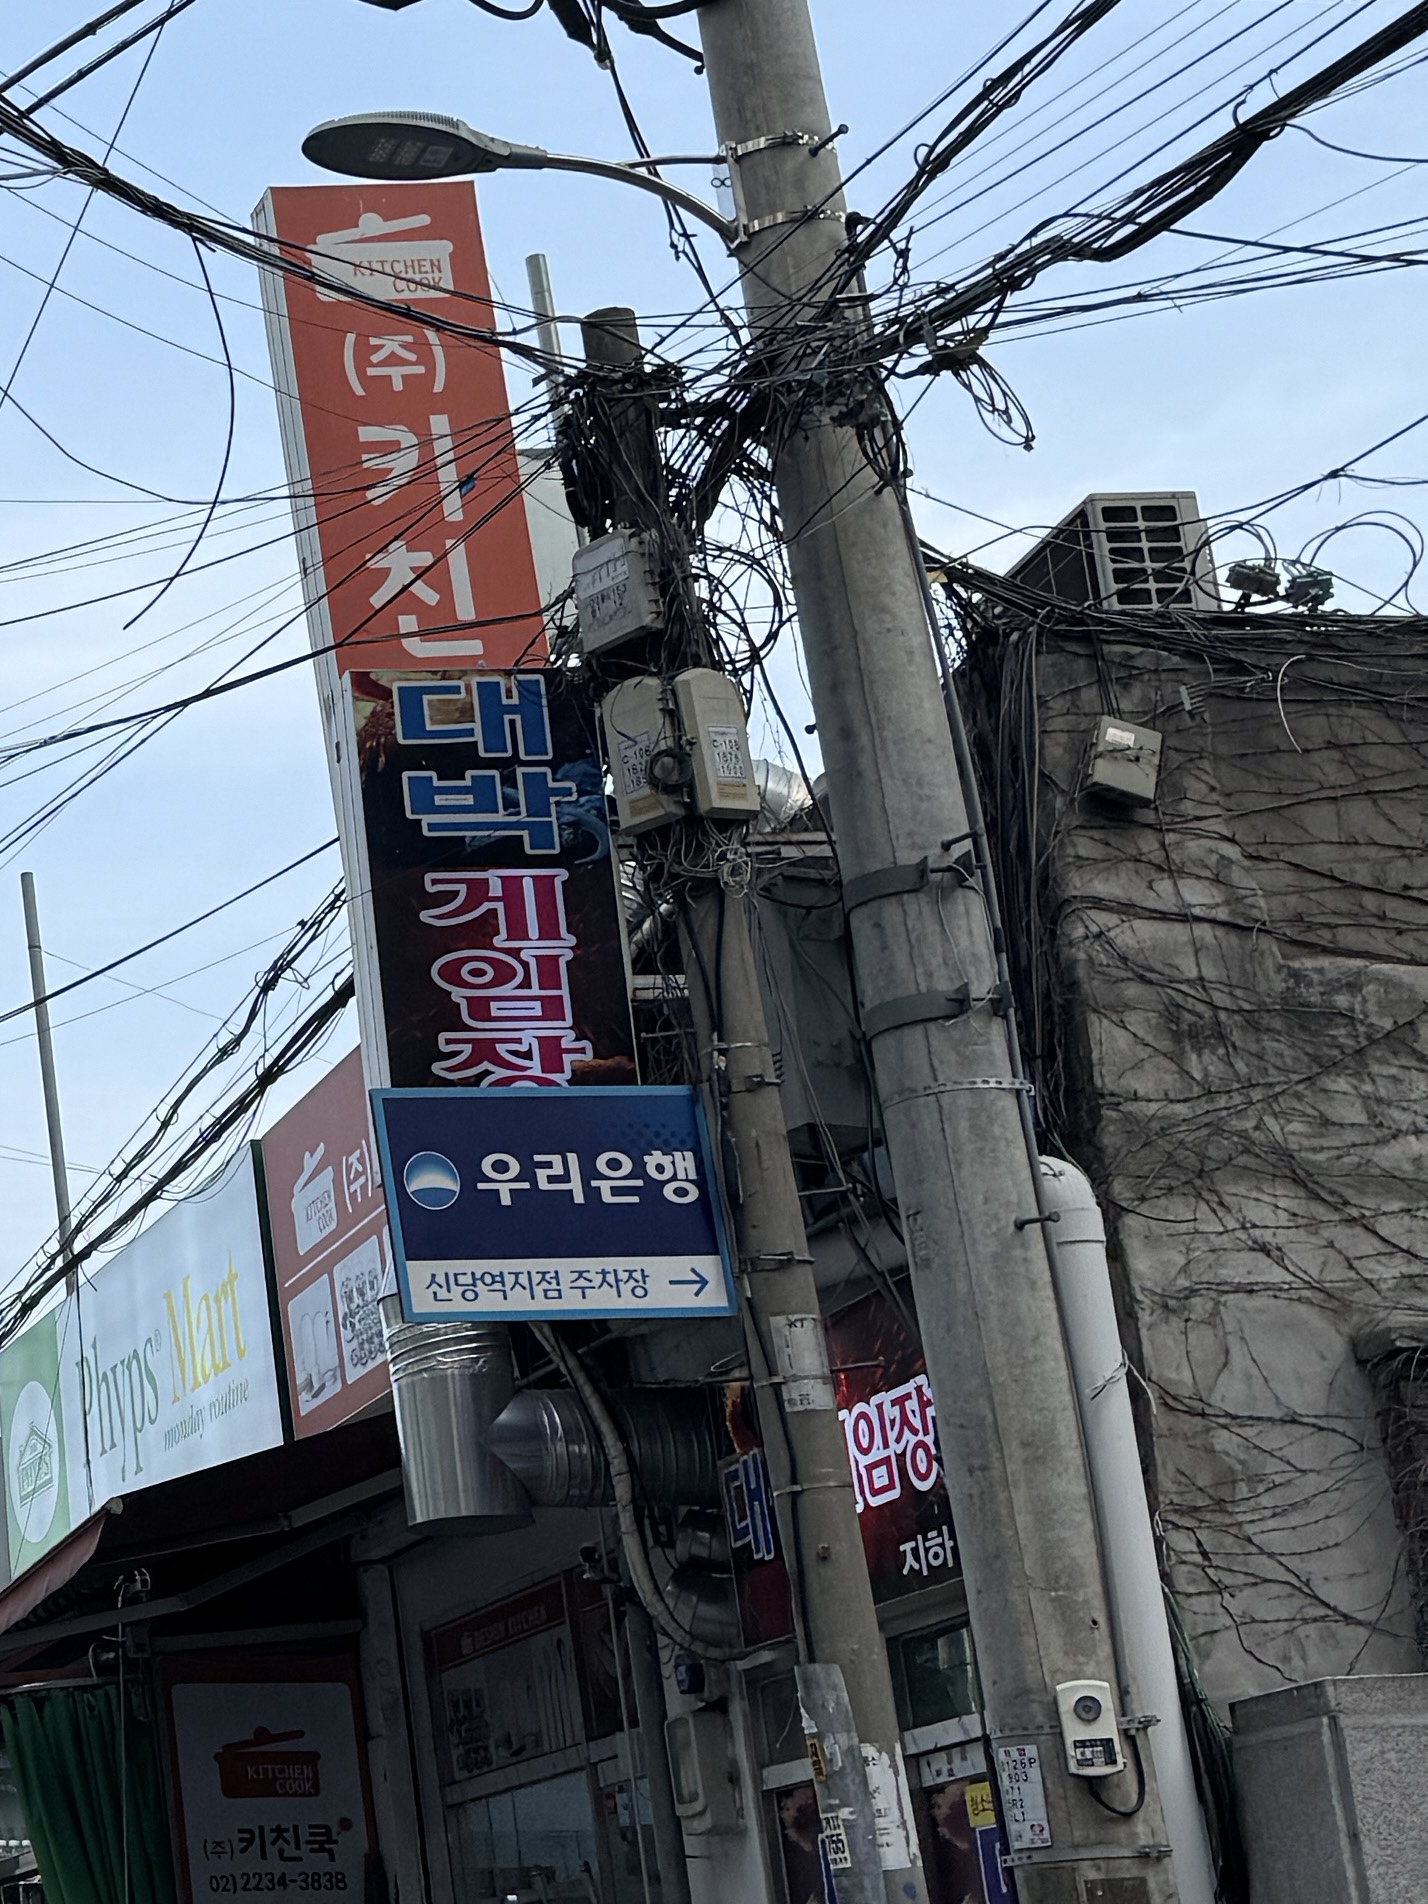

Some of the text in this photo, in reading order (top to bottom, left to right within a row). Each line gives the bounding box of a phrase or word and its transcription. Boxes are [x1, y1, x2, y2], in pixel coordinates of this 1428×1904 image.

[352, 258, 443, 277] KITCHEN
[392, 275, 443, 294] COOK
[476, 1148, 701, 1206] 우리은행
[424, 1267, 650, 1302] 신당역지점 주차장
[163, 1250, 248, 1405] Mart
[163, 1378, 249, 1454] monday routine
[247, 1764, 313, 1780] KITCHEN
[276, 1779, 314, 1794] COOK
